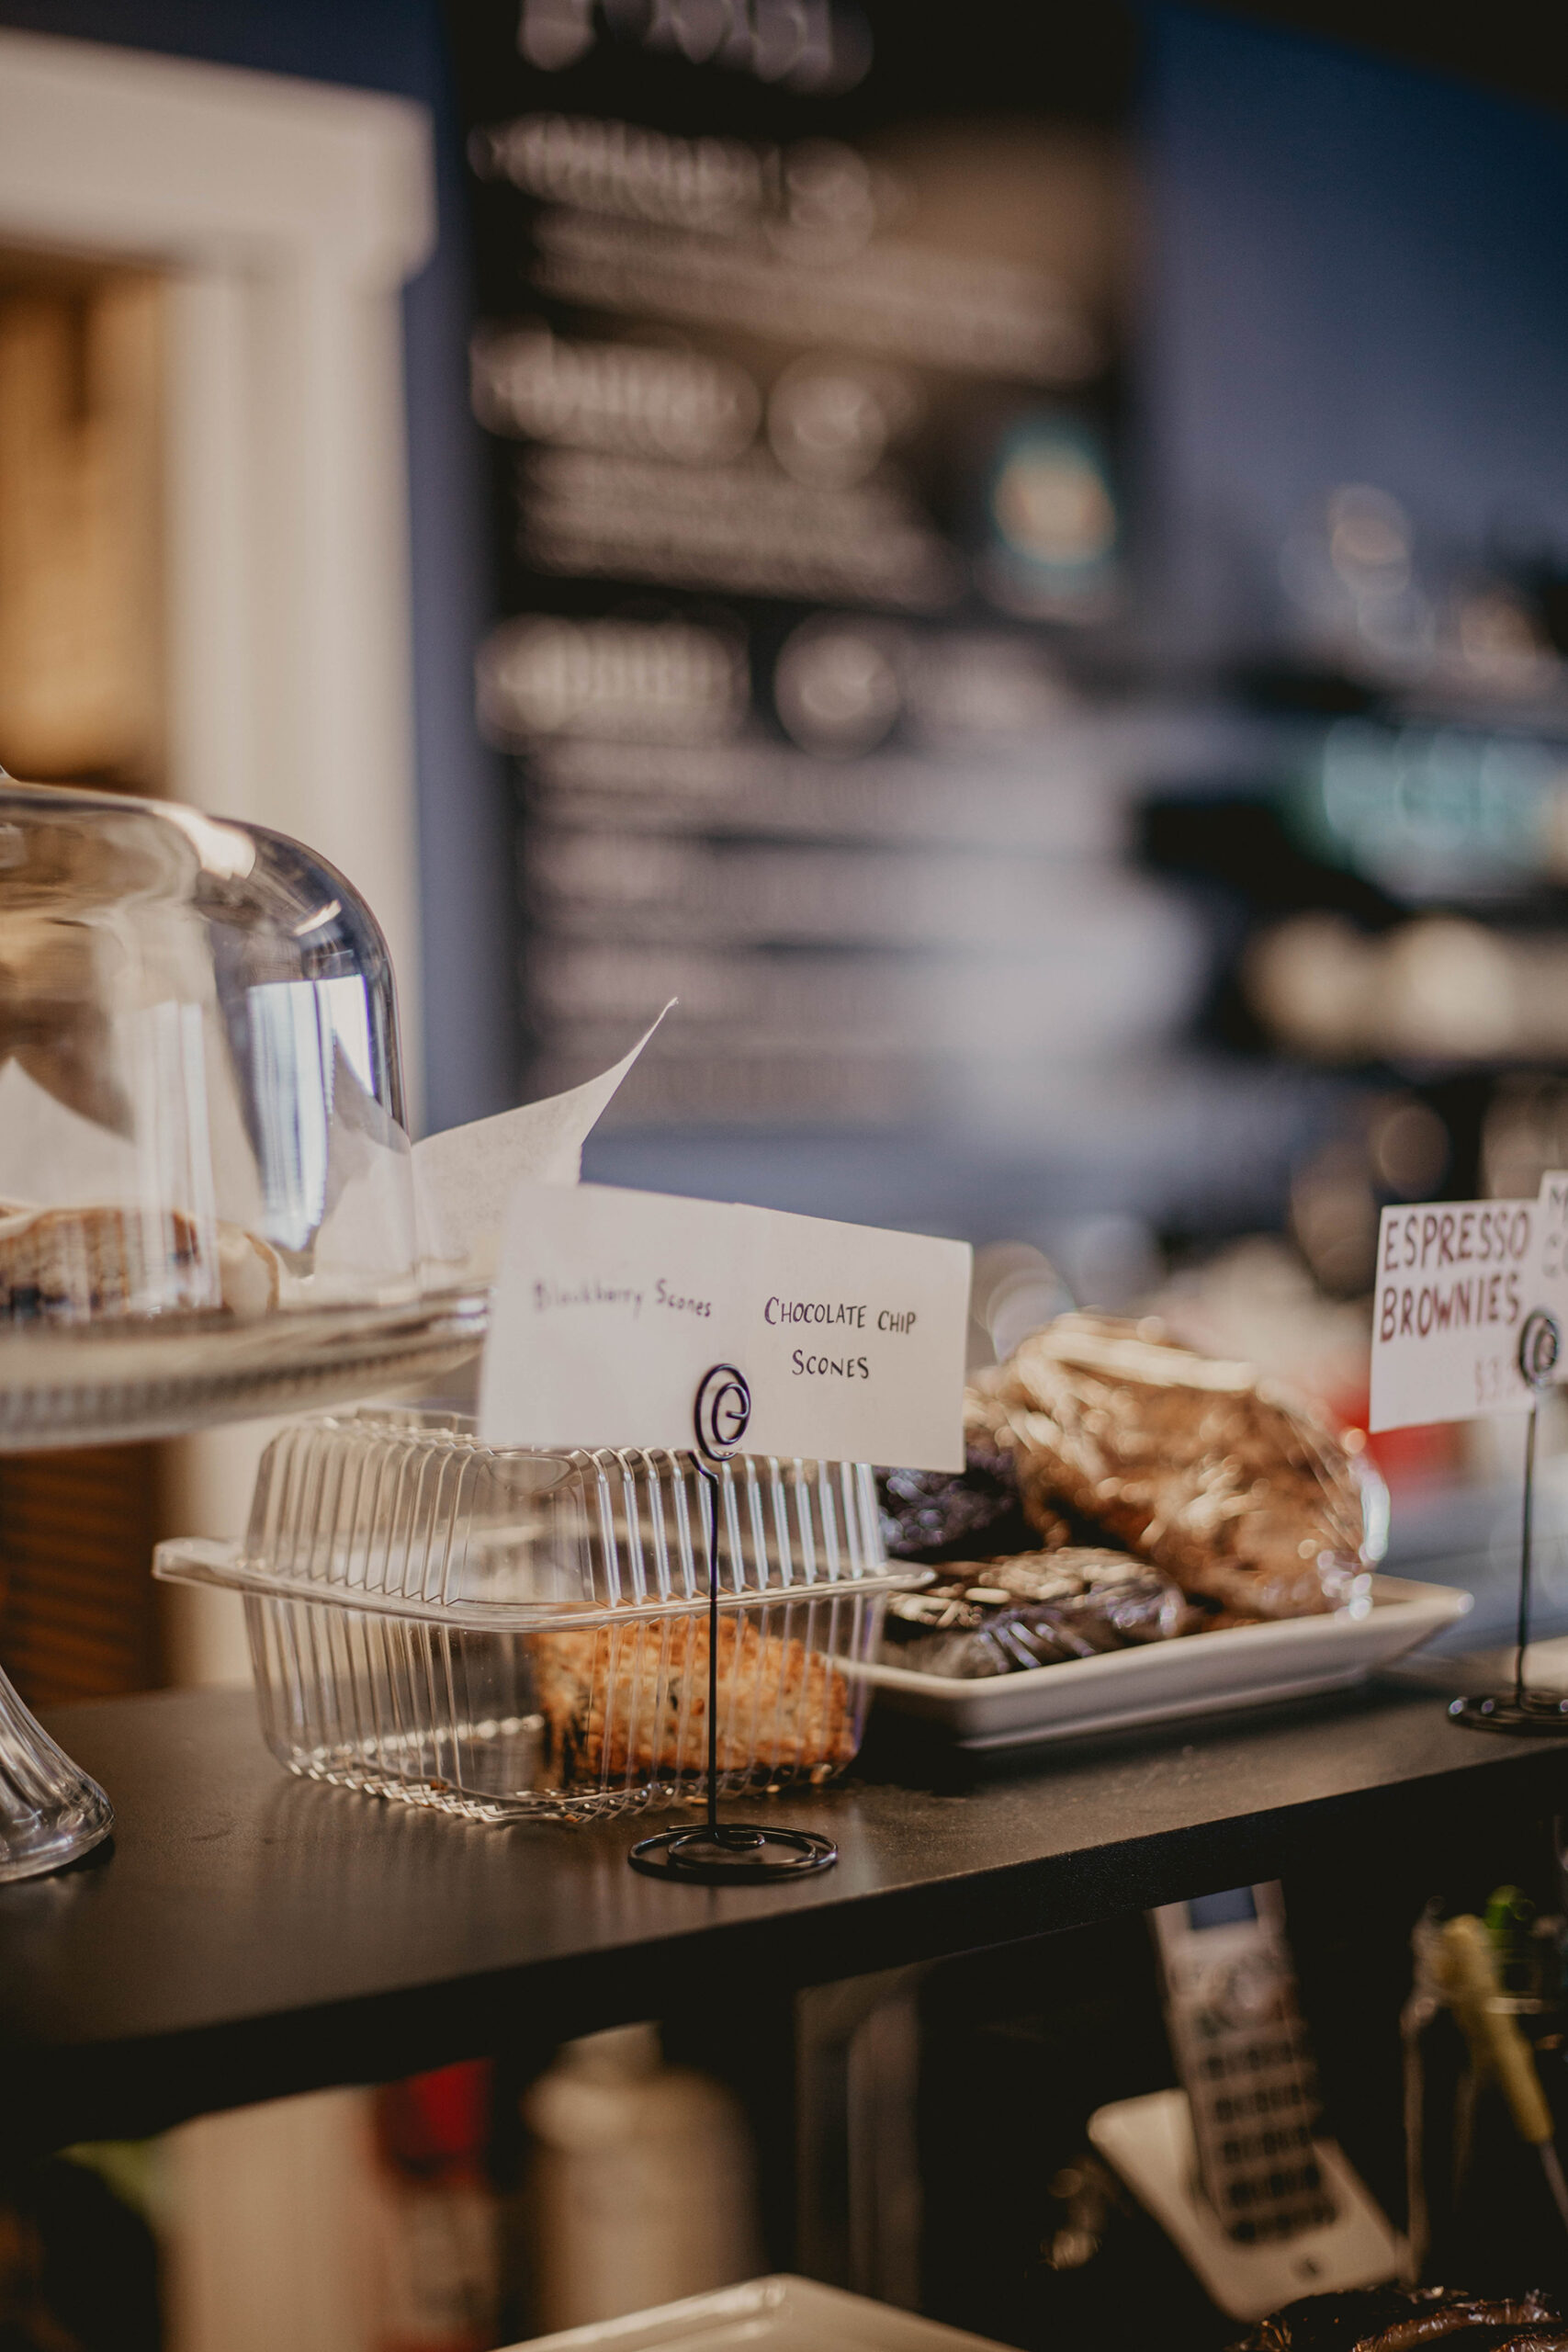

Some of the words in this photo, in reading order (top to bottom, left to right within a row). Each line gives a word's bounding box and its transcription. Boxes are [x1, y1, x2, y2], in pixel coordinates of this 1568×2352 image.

[1384, 1209, 1529, 1272] ESPRESSO
[655, 1278, 712, 1317] Scones
[764, 1296, 867, 1329] CHOCOLATE
[877, 1310, 917, 1335] CHIP
[1380, 1272, 1520, 1343] BROWNIES
[792, 1349, 870, 1379] SCONES
